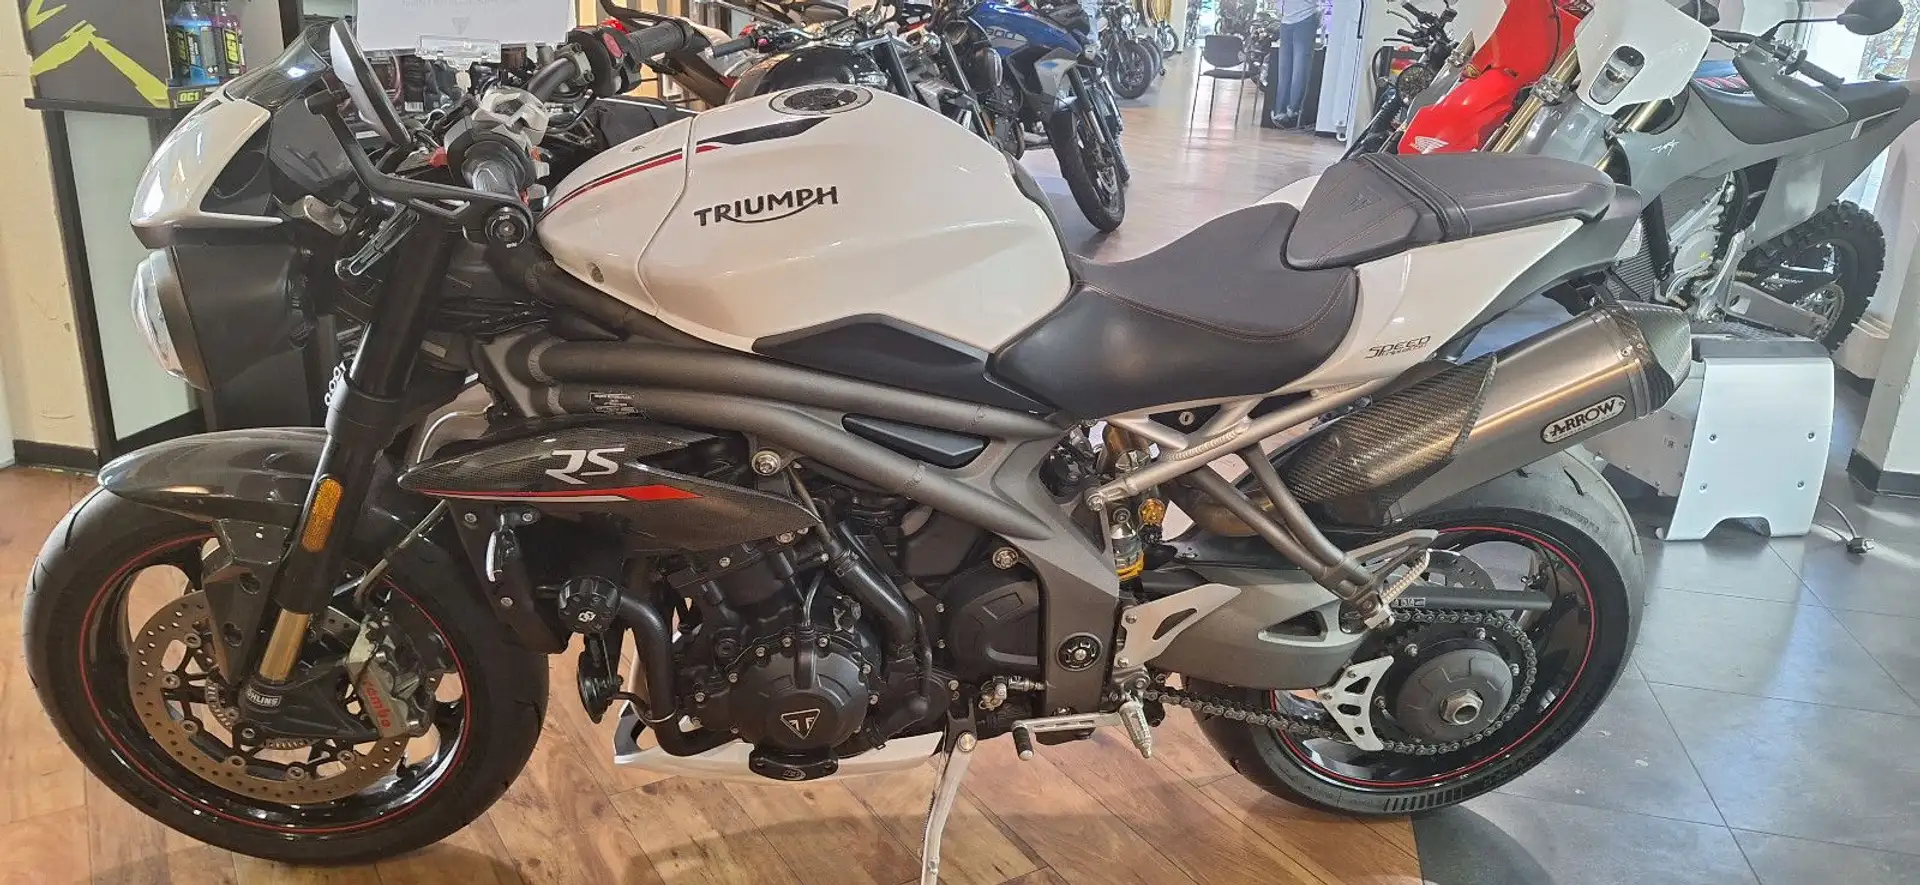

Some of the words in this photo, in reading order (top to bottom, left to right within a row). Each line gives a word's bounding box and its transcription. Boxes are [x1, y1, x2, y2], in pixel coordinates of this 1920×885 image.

[225, 32, 239, 62] OC1
[179, 91, 200, 102] OC1
[694, 186, 838, 226] TRIUMPH
[1364, 336, 1431, 359] SPEED
[1550, 399, 1616, 437] ARROW
[545, 448, 625, 484] RS
